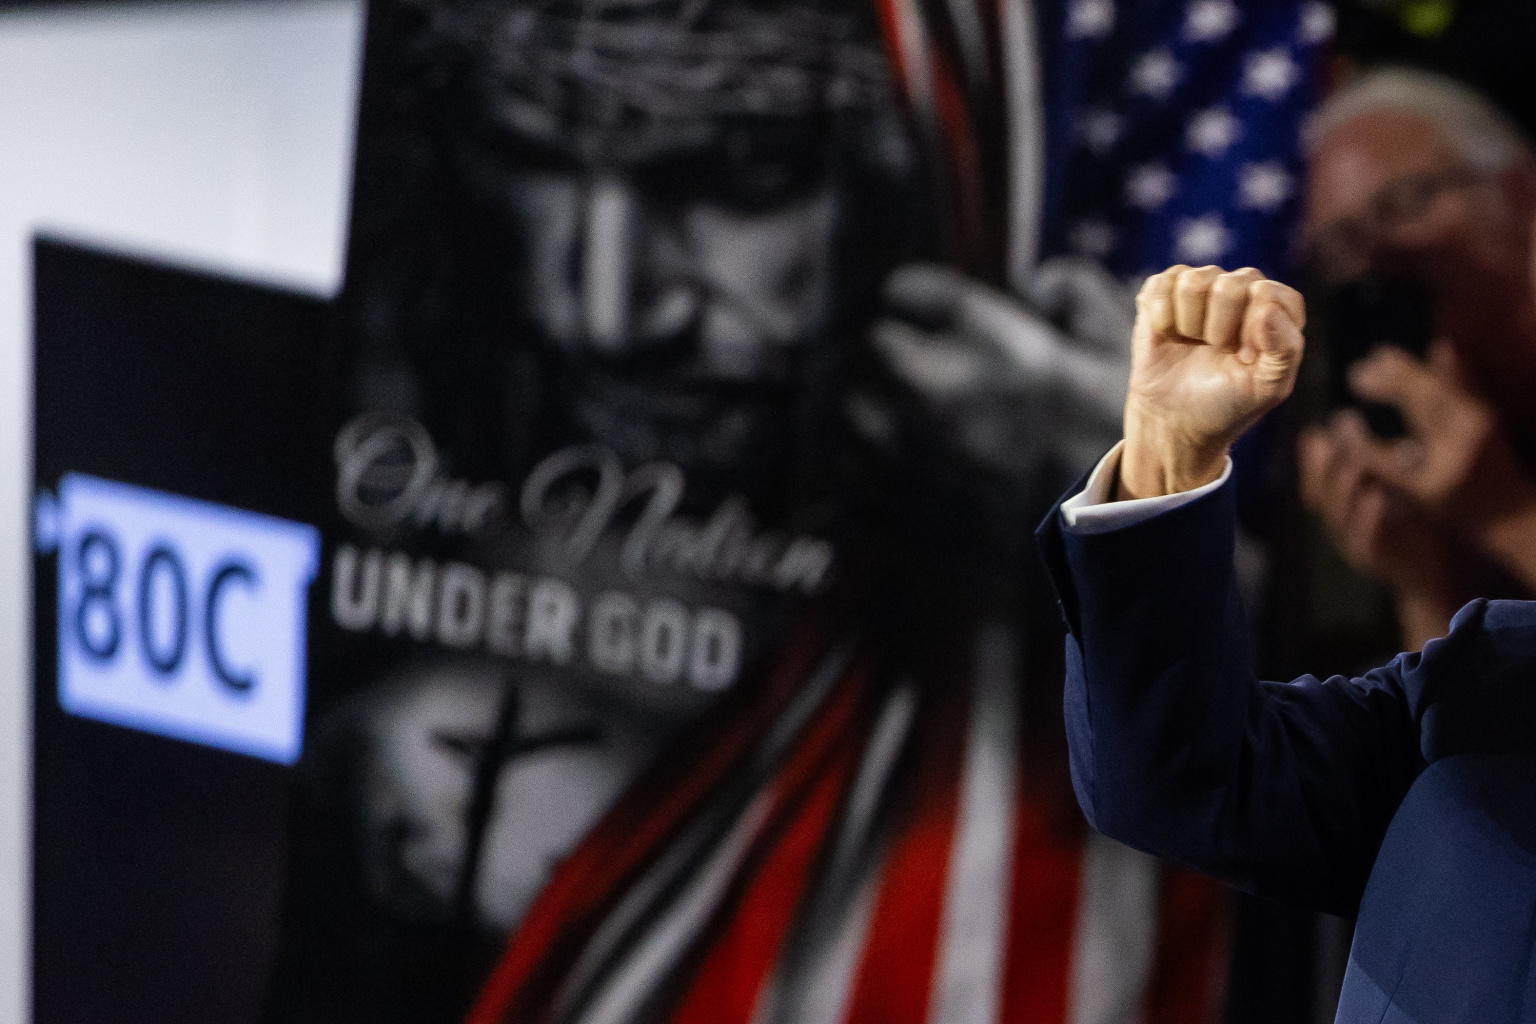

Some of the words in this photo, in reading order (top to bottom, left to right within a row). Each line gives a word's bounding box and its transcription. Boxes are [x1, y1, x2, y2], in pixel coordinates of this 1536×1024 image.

[334, 410, 504, 532] One
[520, 446, 834, 592] Nation
[72, 528, 260, 697] 80C
[331, 546, 582, 664] UNDER
[588, 602, 743, 690] GOD
